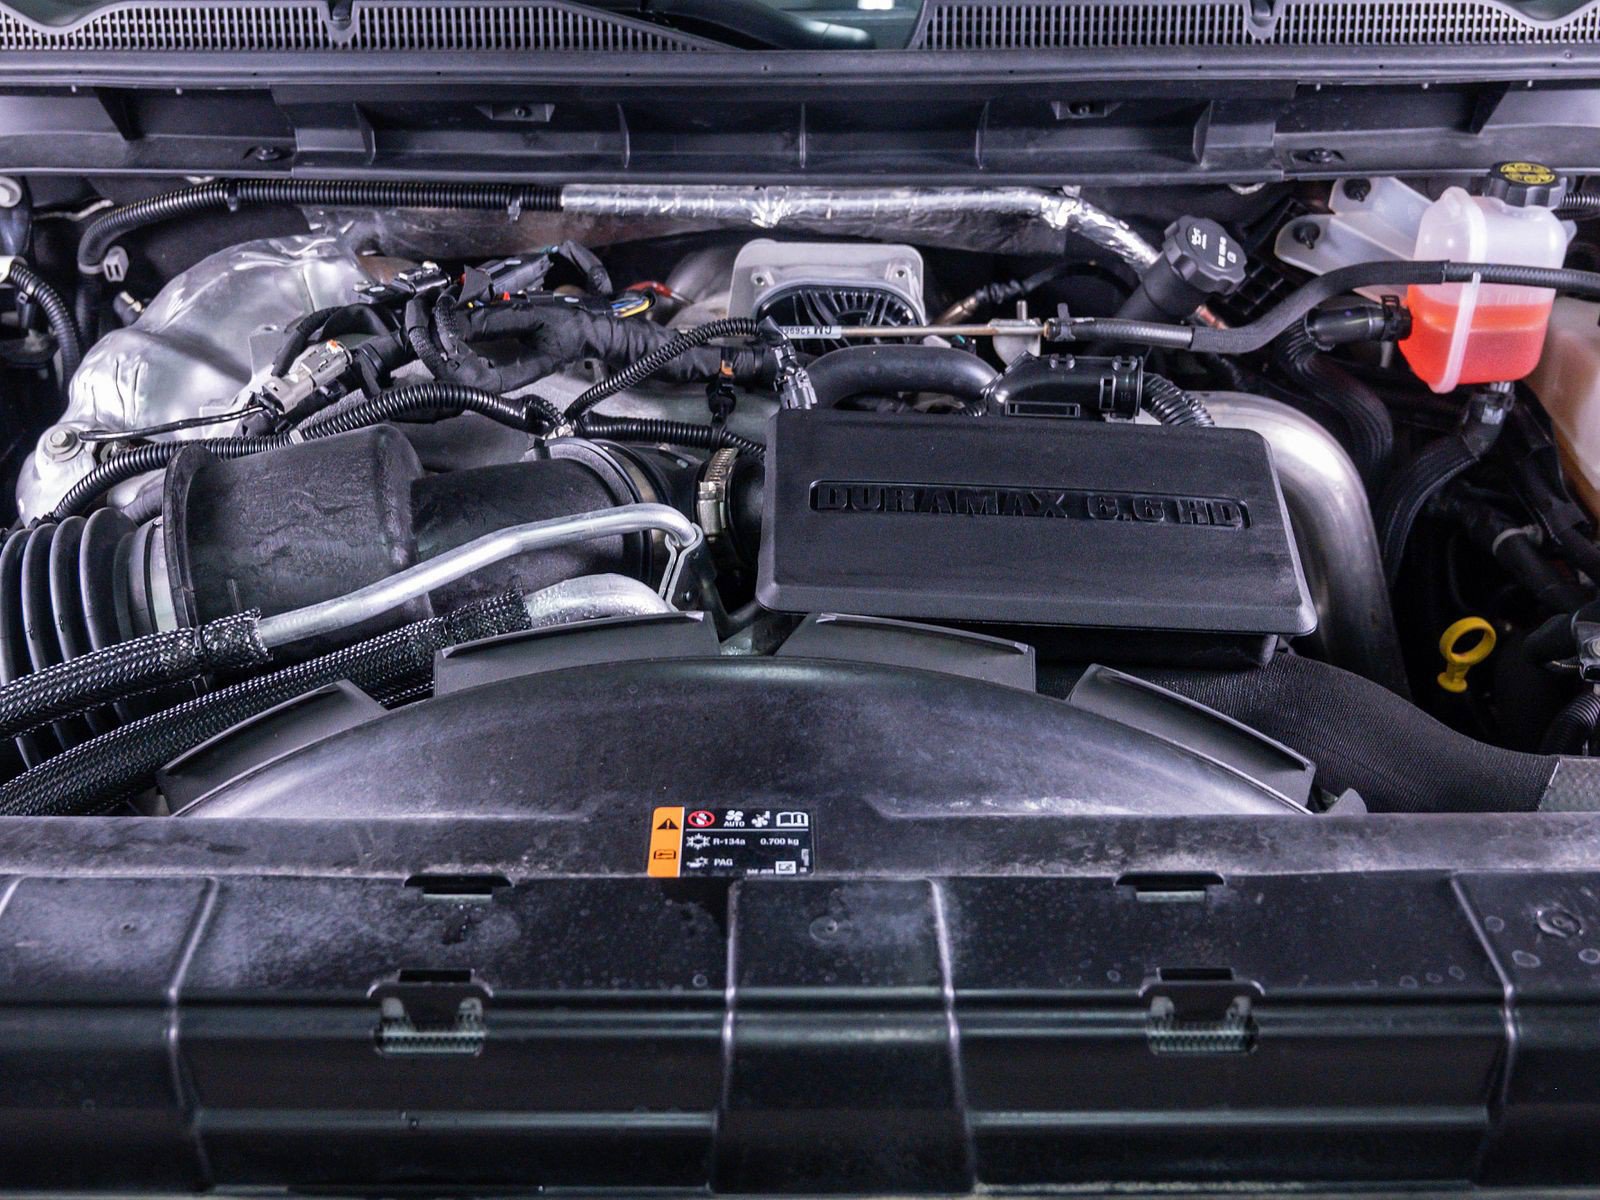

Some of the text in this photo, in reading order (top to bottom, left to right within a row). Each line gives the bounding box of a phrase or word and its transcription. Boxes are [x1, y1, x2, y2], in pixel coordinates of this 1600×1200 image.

[814, 325, 832, 334] GM
[816, 486, 1244, 529] DURAMAX 6.6 HD
[713, 838, 800, 847] R-134a 0.700 kg
[713, 858, 734, 867] PAG
